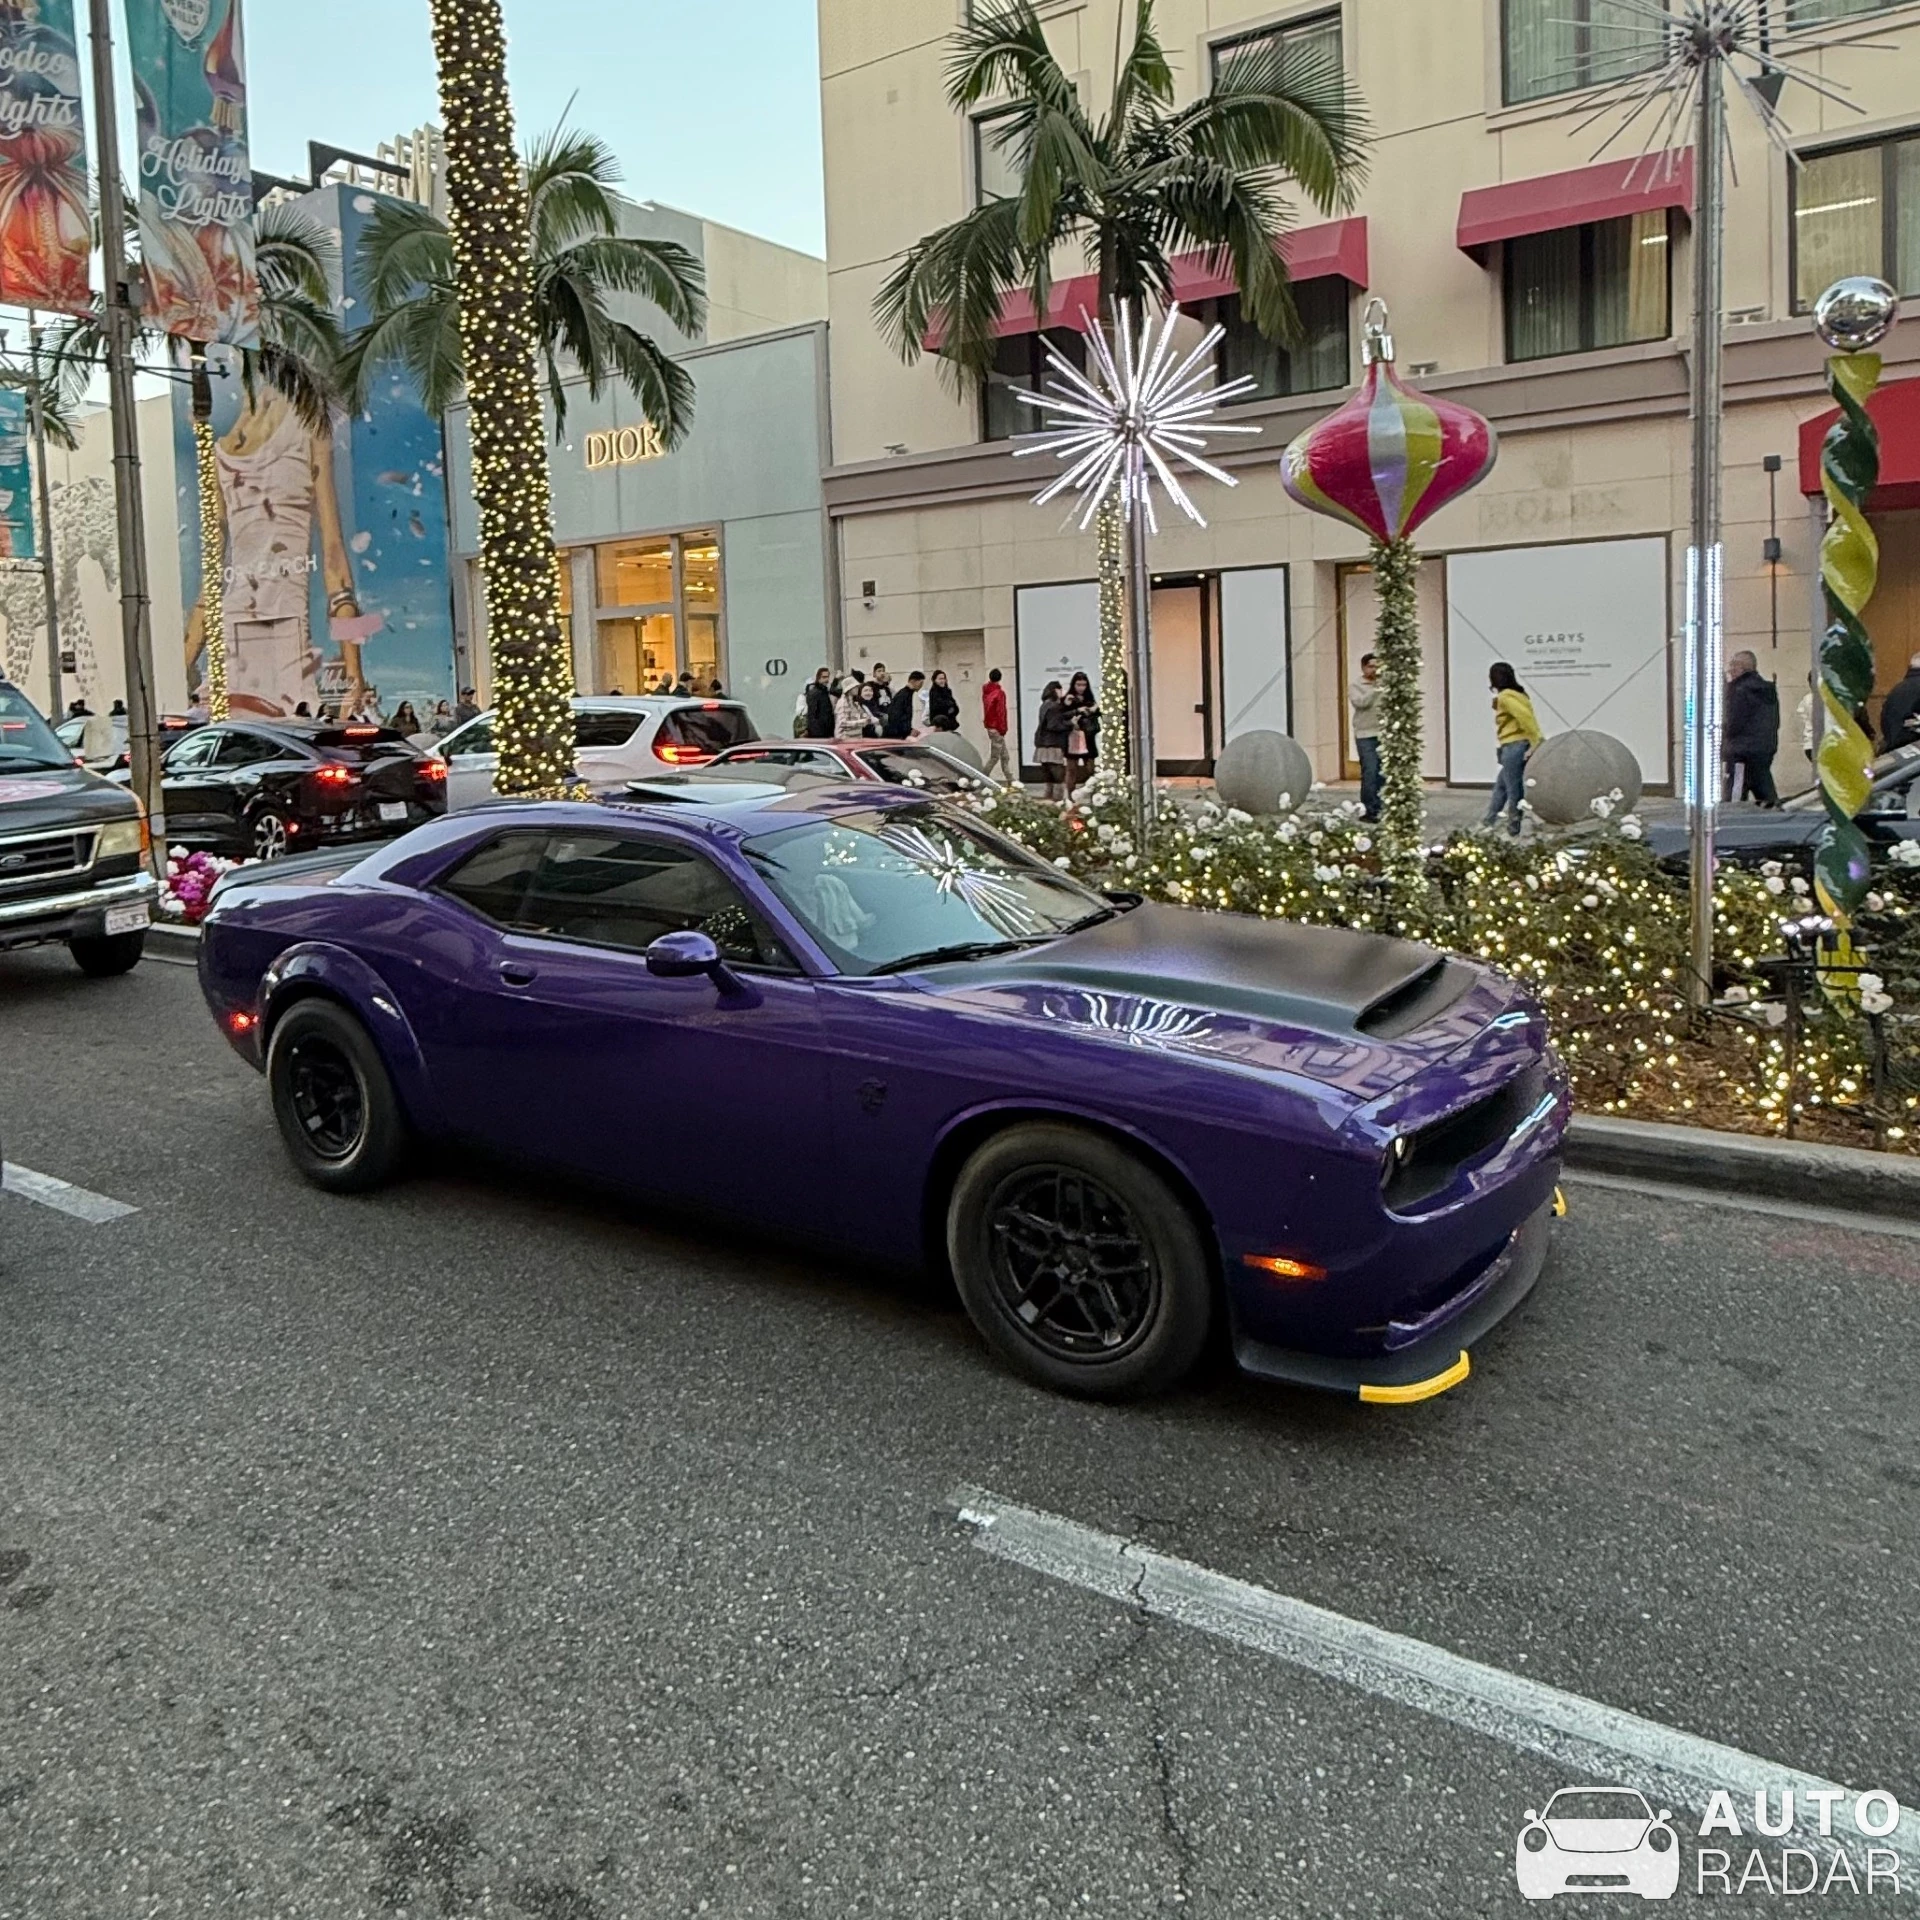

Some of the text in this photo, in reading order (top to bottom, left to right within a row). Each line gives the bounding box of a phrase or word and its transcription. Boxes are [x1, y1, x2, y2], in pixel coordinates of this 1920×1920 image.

[0, 41, 72, 87] odeo
[0, 91, 79, 139] ights
[141, 136, 247, 186] Holiday
[158, 183, 251, 226] Lights
[586, 425, 664, 468] DIOR
[1524, 633, 1585, 645] GEARYS
